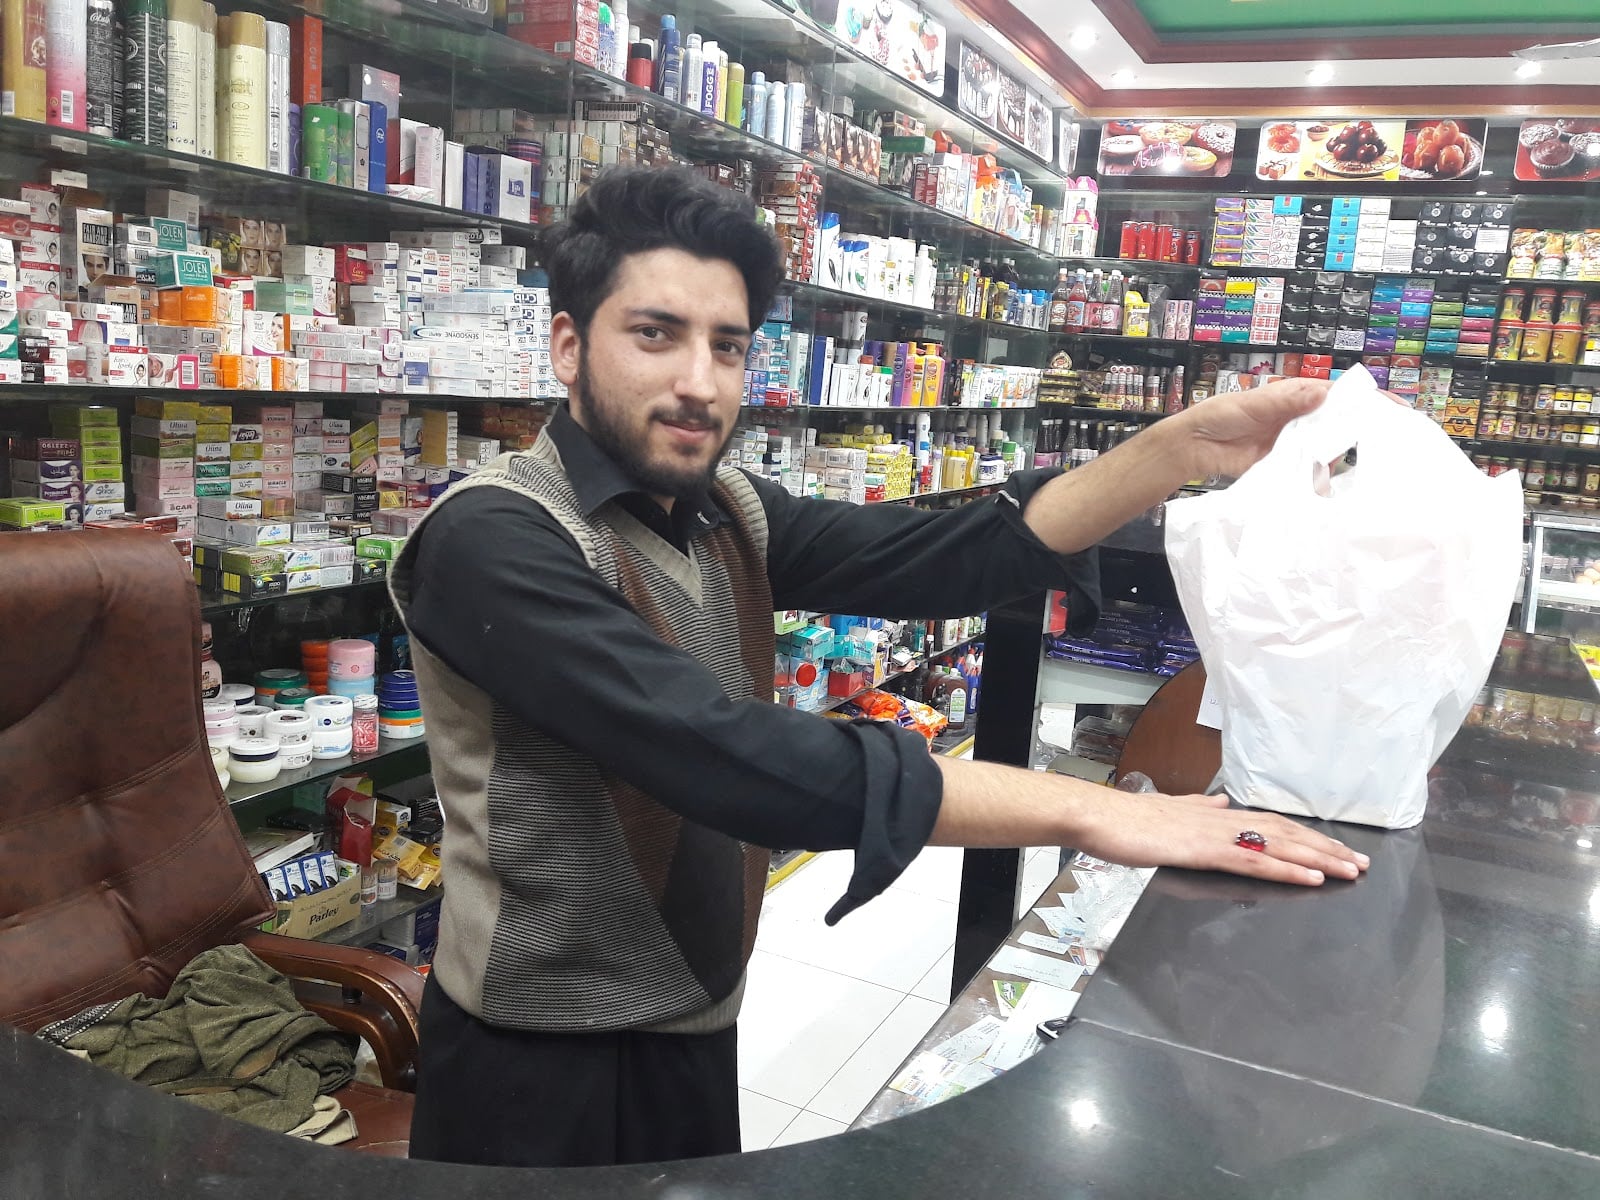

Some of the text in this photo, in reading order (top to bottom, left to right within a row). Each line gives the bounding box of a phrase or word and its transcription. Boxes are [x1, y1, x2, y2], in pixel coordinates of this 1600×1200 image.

[83, 223, 108, 237] FAIR AND
[159, 225, 183, 239] JOLEN
[181, 261, 208, 275] JOLEN
[444, 332, 480, 340] SENSODYNE
[309, 907, 339, 925] Parley
